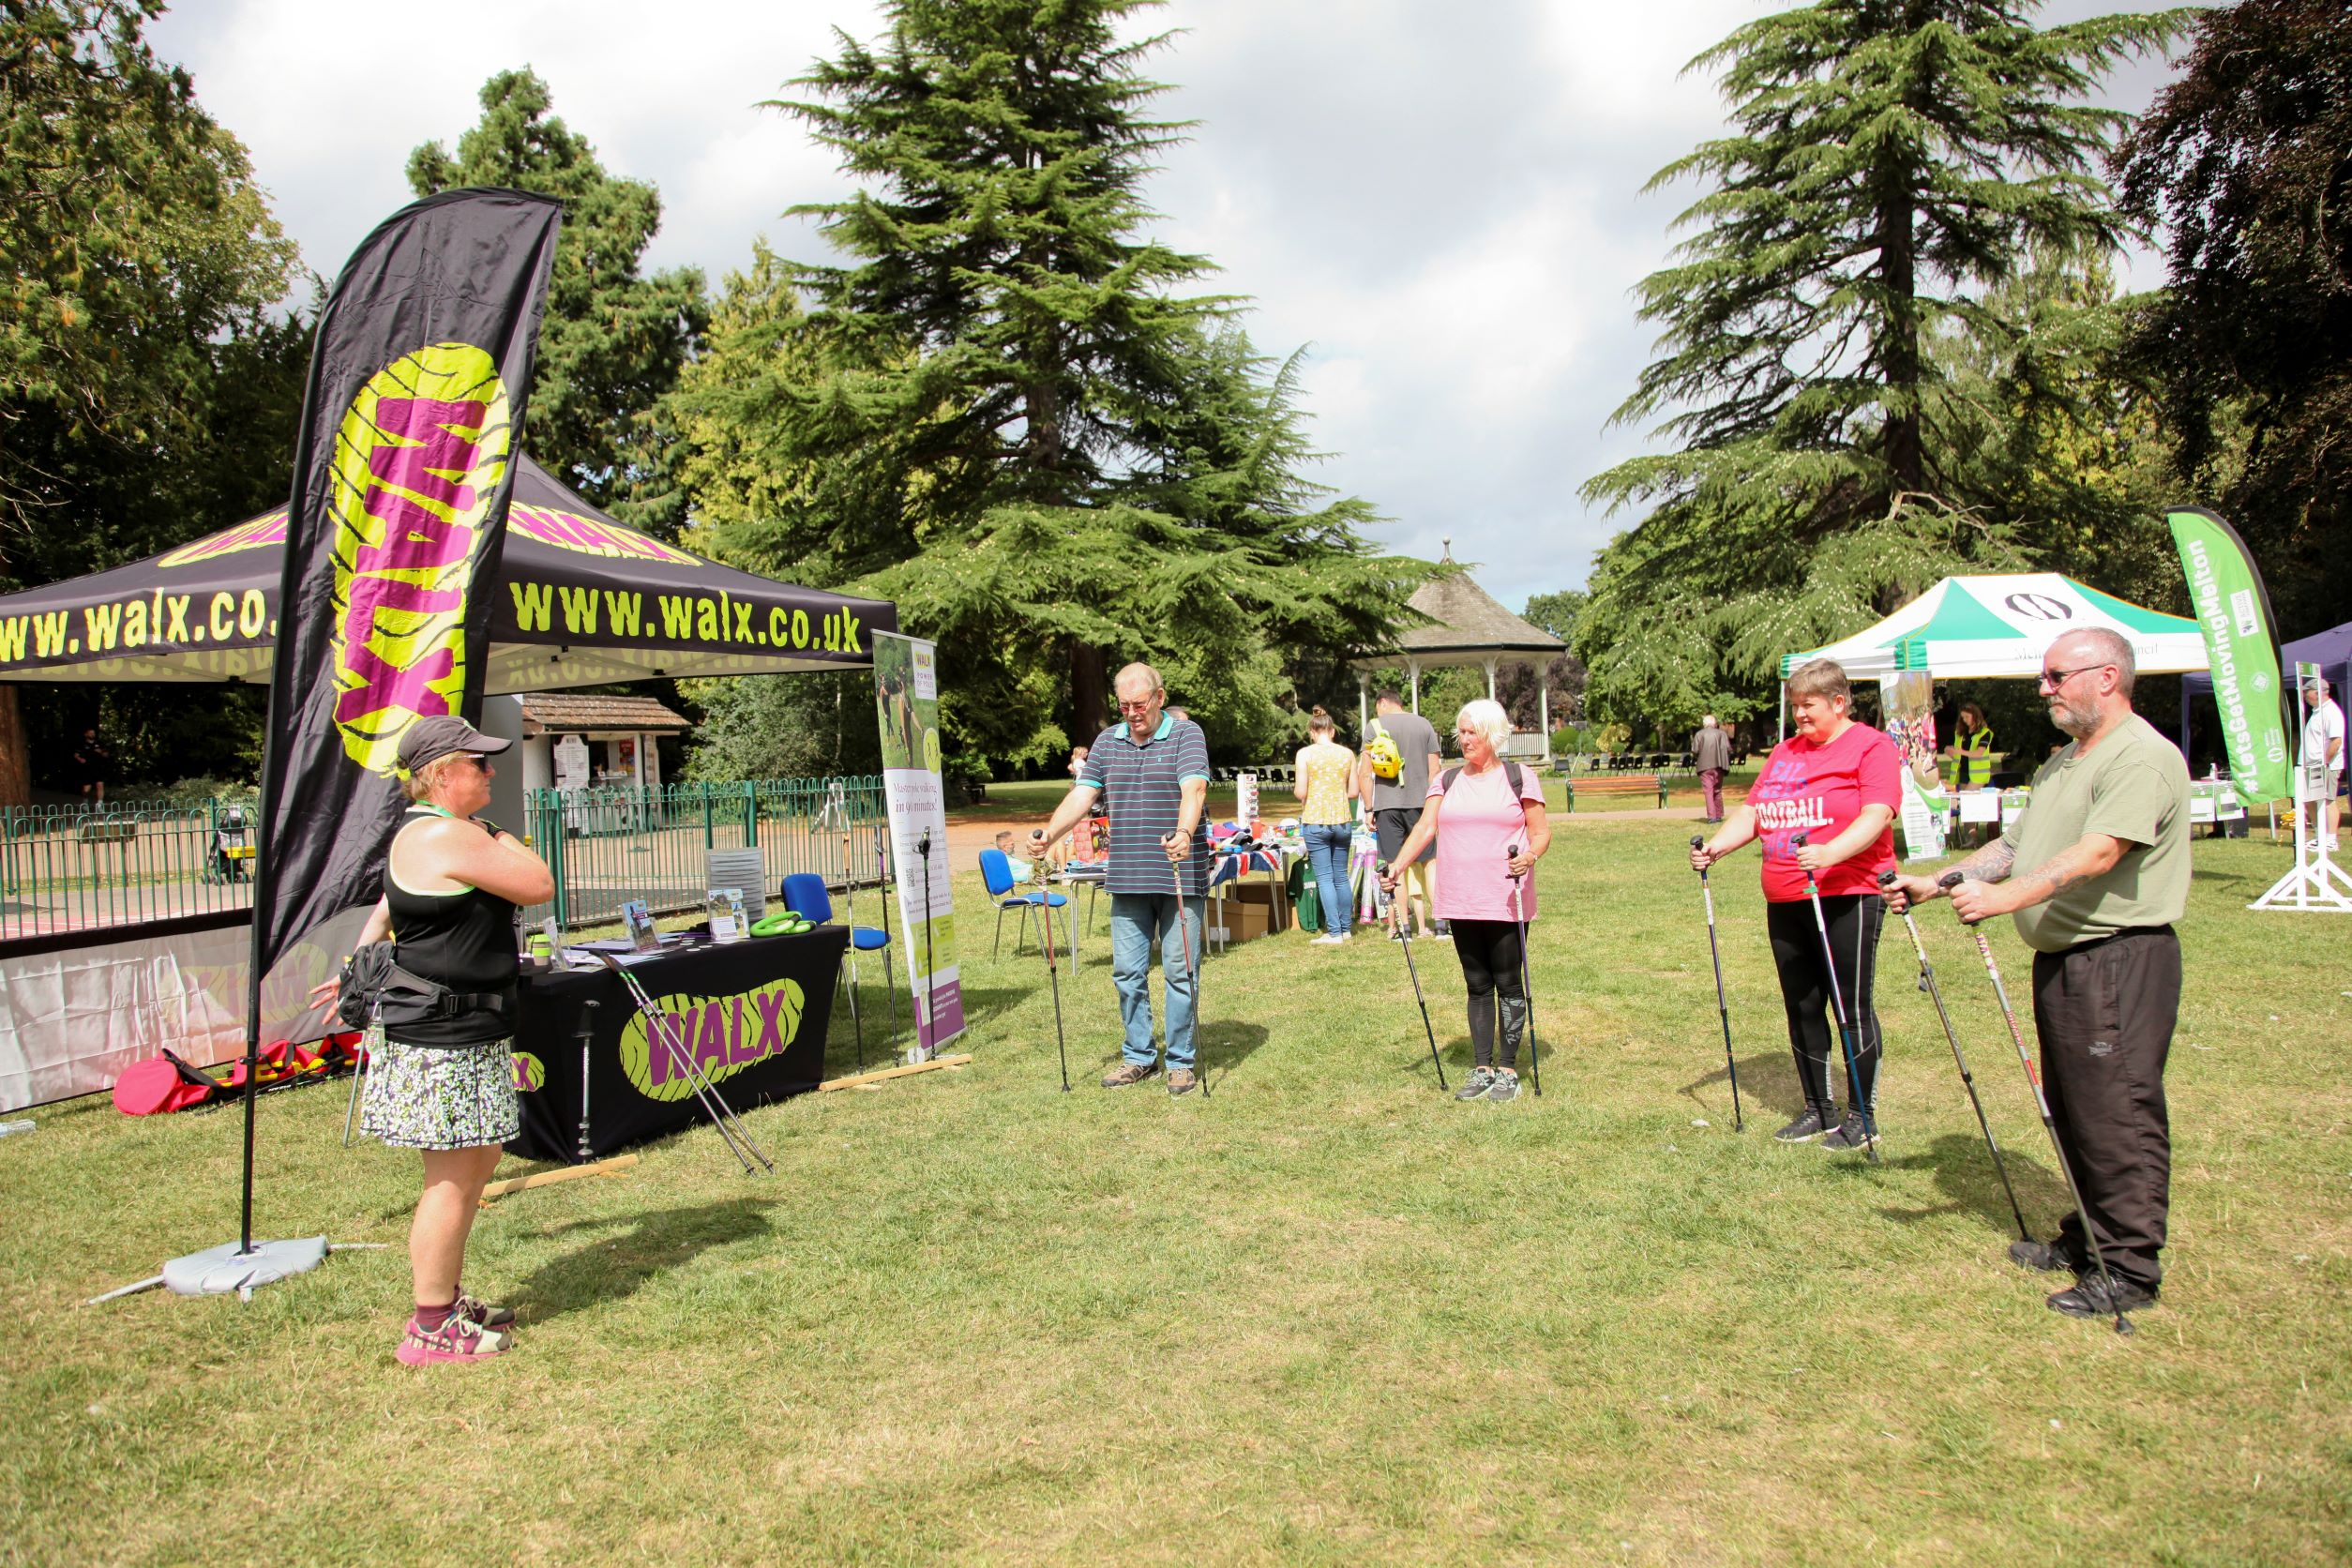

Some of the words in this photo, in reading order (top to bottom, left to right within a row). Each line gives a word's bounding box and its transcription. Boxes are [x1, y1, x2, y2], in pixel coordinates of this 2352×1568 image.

[335, 397, 486, 724] WALX
[509, 581, 863, 654] www.walx.co.uk
[2188, 539, 2260, 794] #LetsGetMovingMelton
[645, 988, 786, 1088] WALX
